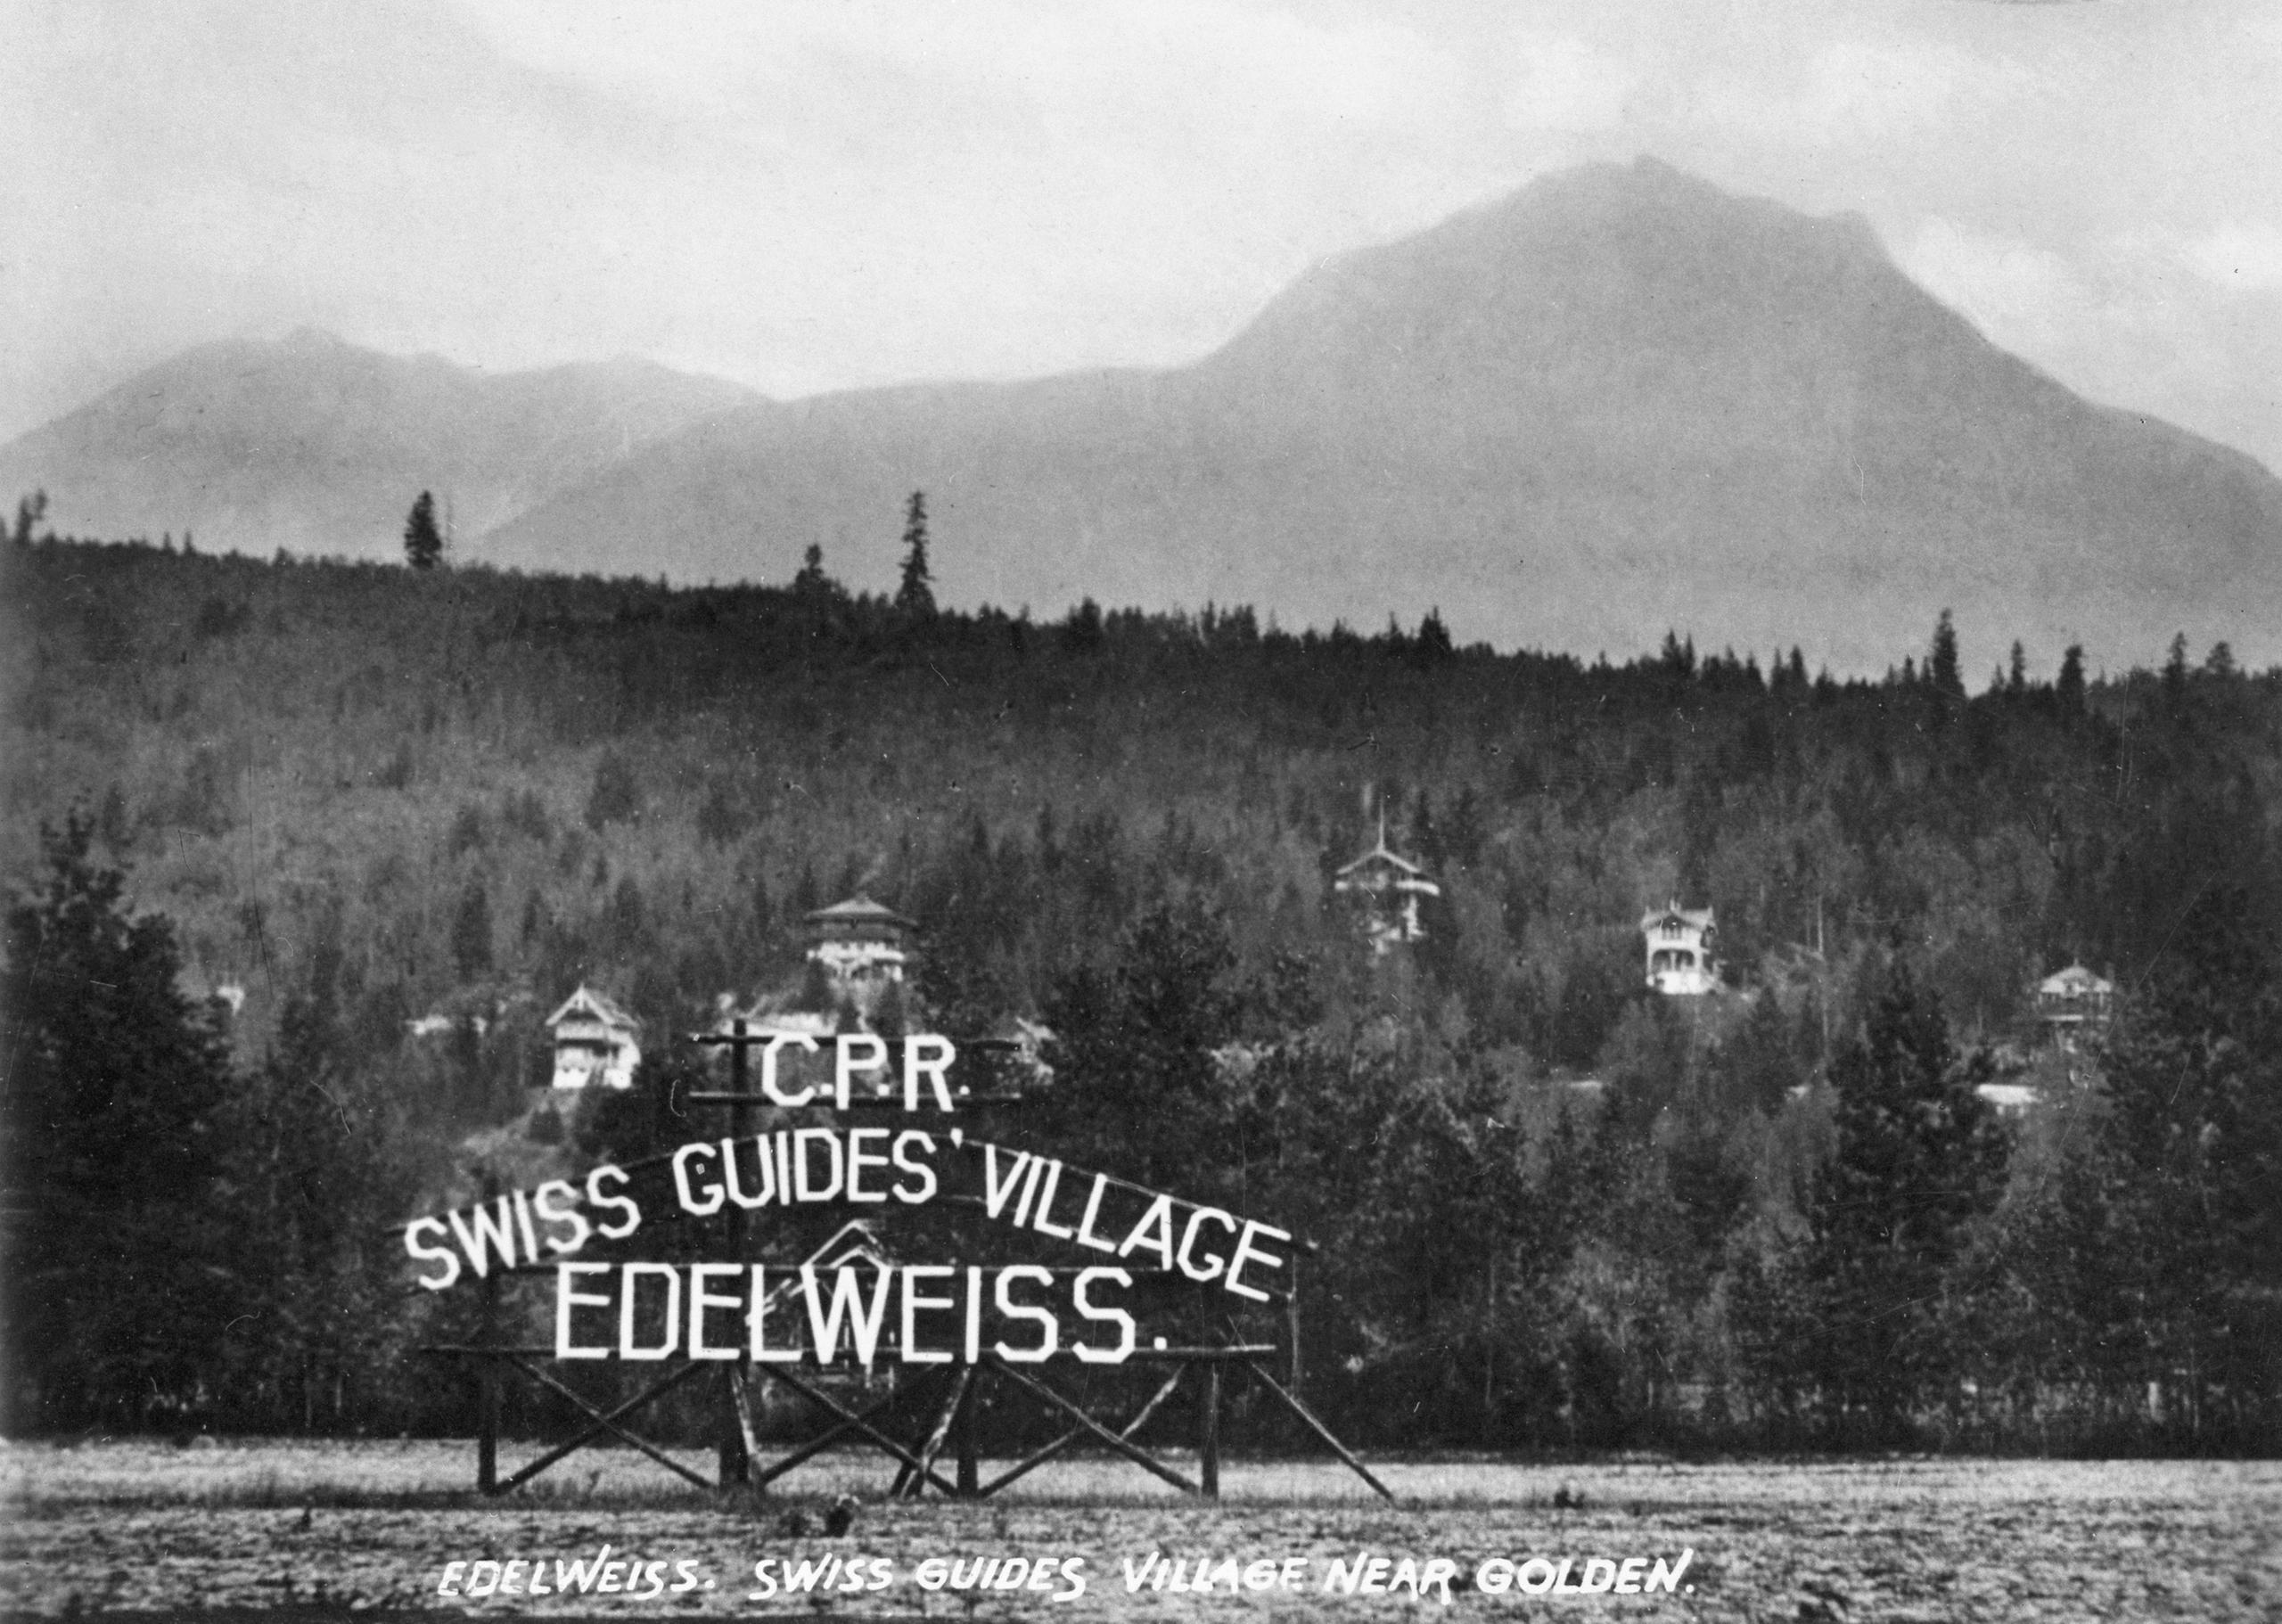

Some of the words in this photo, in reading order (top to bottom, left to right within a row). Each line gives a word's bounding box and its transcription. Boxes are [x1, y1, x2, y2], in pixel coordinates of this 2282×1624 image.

[762, 1033, 970, 1111] C.P.R.
[405, 1165, 641, 1290] SWISS
[672, 1128, 963, 1216] GUIDES'
[985, 1144, 1292, 1301] VILLAGE
[555, 1262, 1168, 1365] EDELWEISS.
